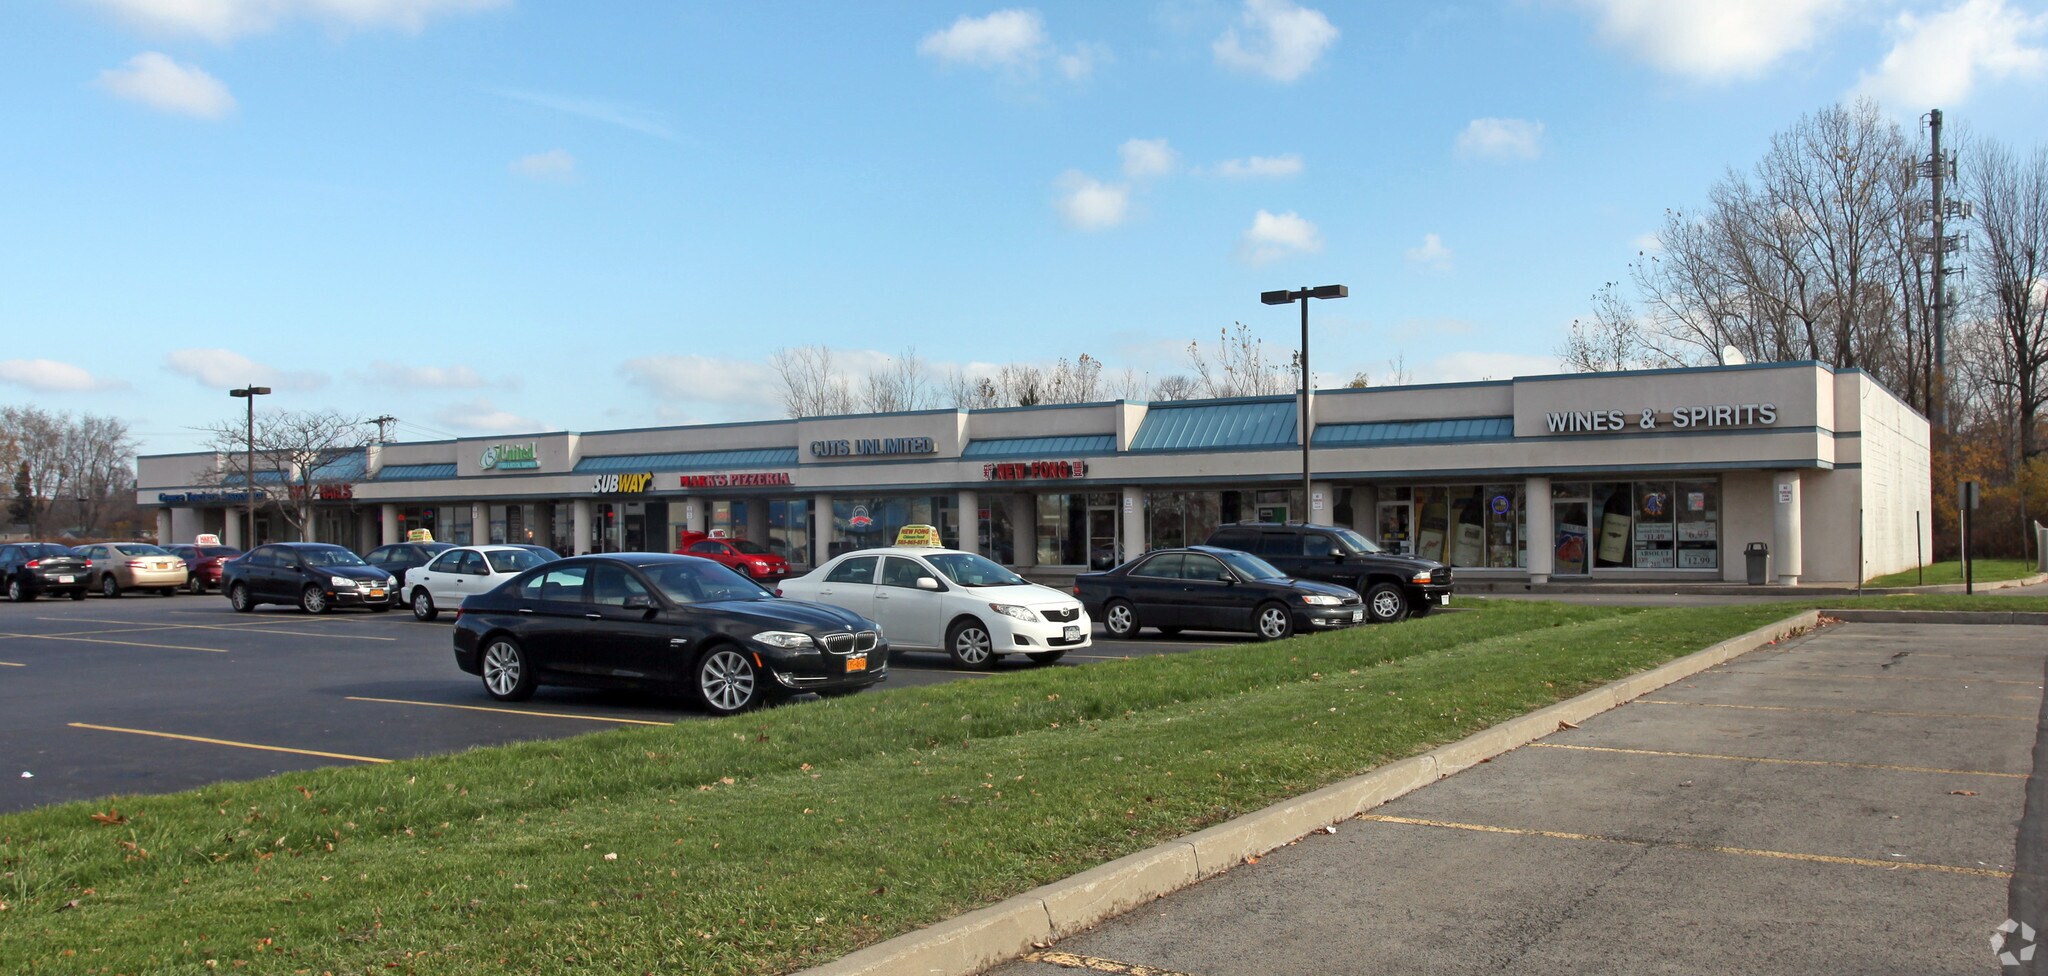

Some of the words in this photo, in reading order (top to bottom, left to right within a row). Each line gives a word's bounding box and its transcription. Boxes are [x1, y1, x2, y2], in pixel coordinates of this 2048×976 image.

[1546, 410, 1625, 433] WINES
[1640, 407, 1656, 429] &
[1672, 403, 1777, 428] SPIRITS
[495, 442, 537, 461] United
[810, 439, 849, 457] CUTS
[855, 437, 934, 455] UNLIMITED
[680, 475, 727, 487] MARK'S
[730, 473, 791, 486] PIZZERIA
[997, 463, 1026, 480] NEW
[1031, 460, 1068, 479] FONG
[592, 471, 654, 493] SUBWAY
